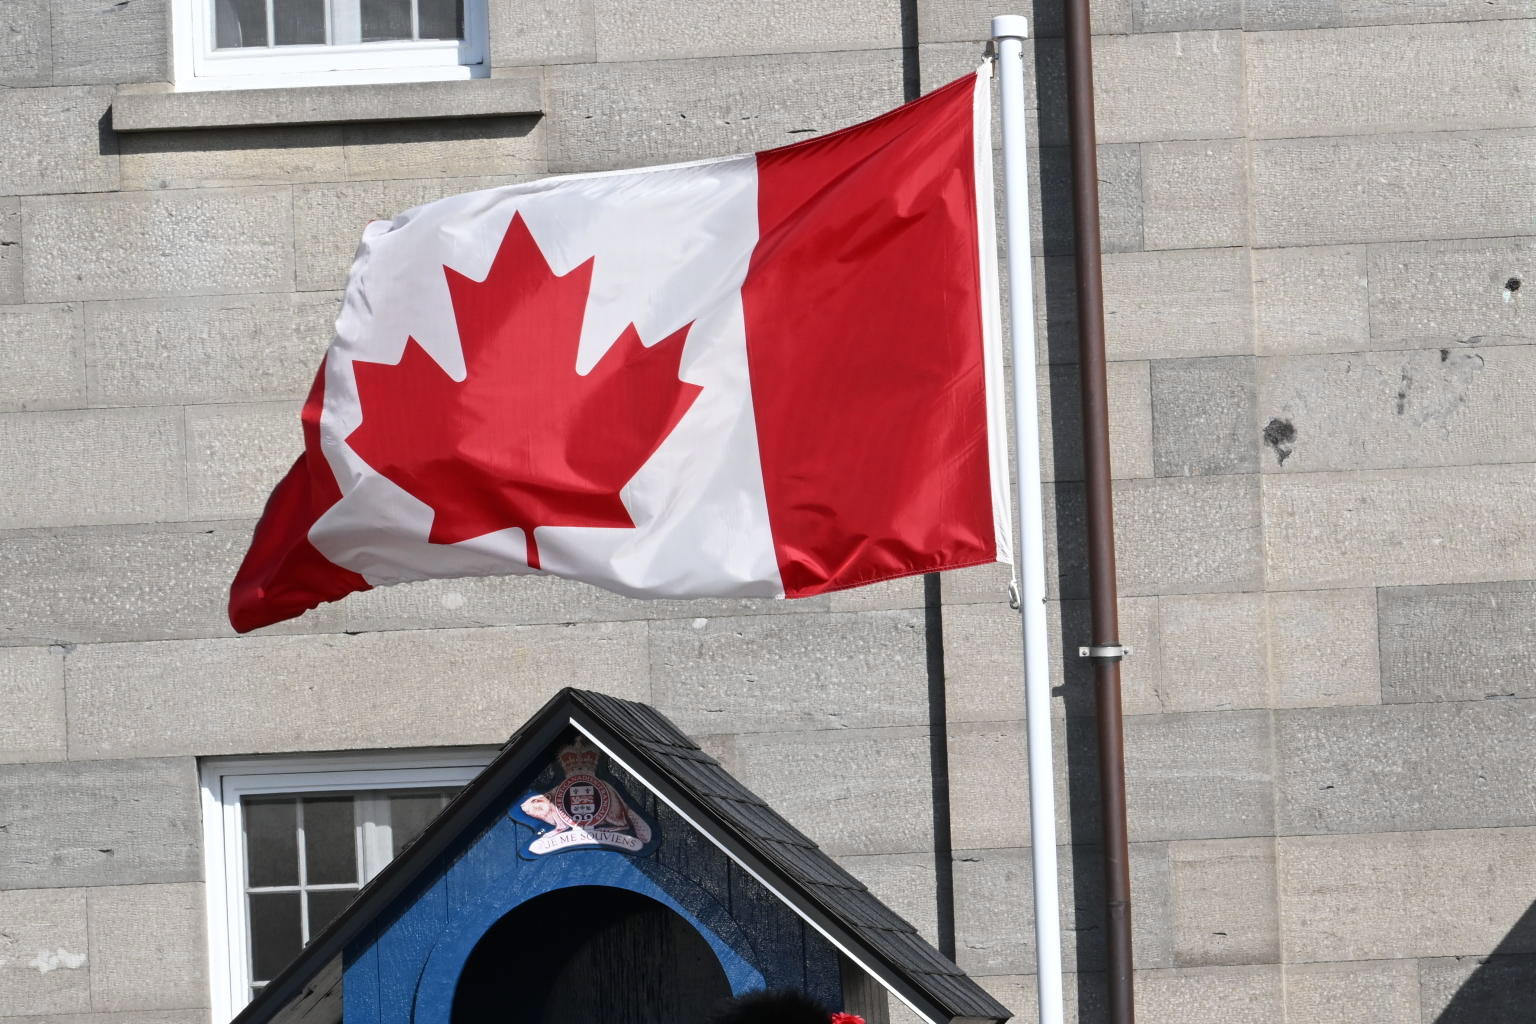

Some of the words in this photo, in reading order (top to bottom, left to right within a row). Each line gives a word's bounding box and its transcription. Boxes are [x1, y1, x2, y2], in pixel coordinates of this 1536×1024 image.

[545, 839, 558, 849] JE
[560, 834, 577, 843] ME
[580, 832, 637, 848] SOUVIENS
